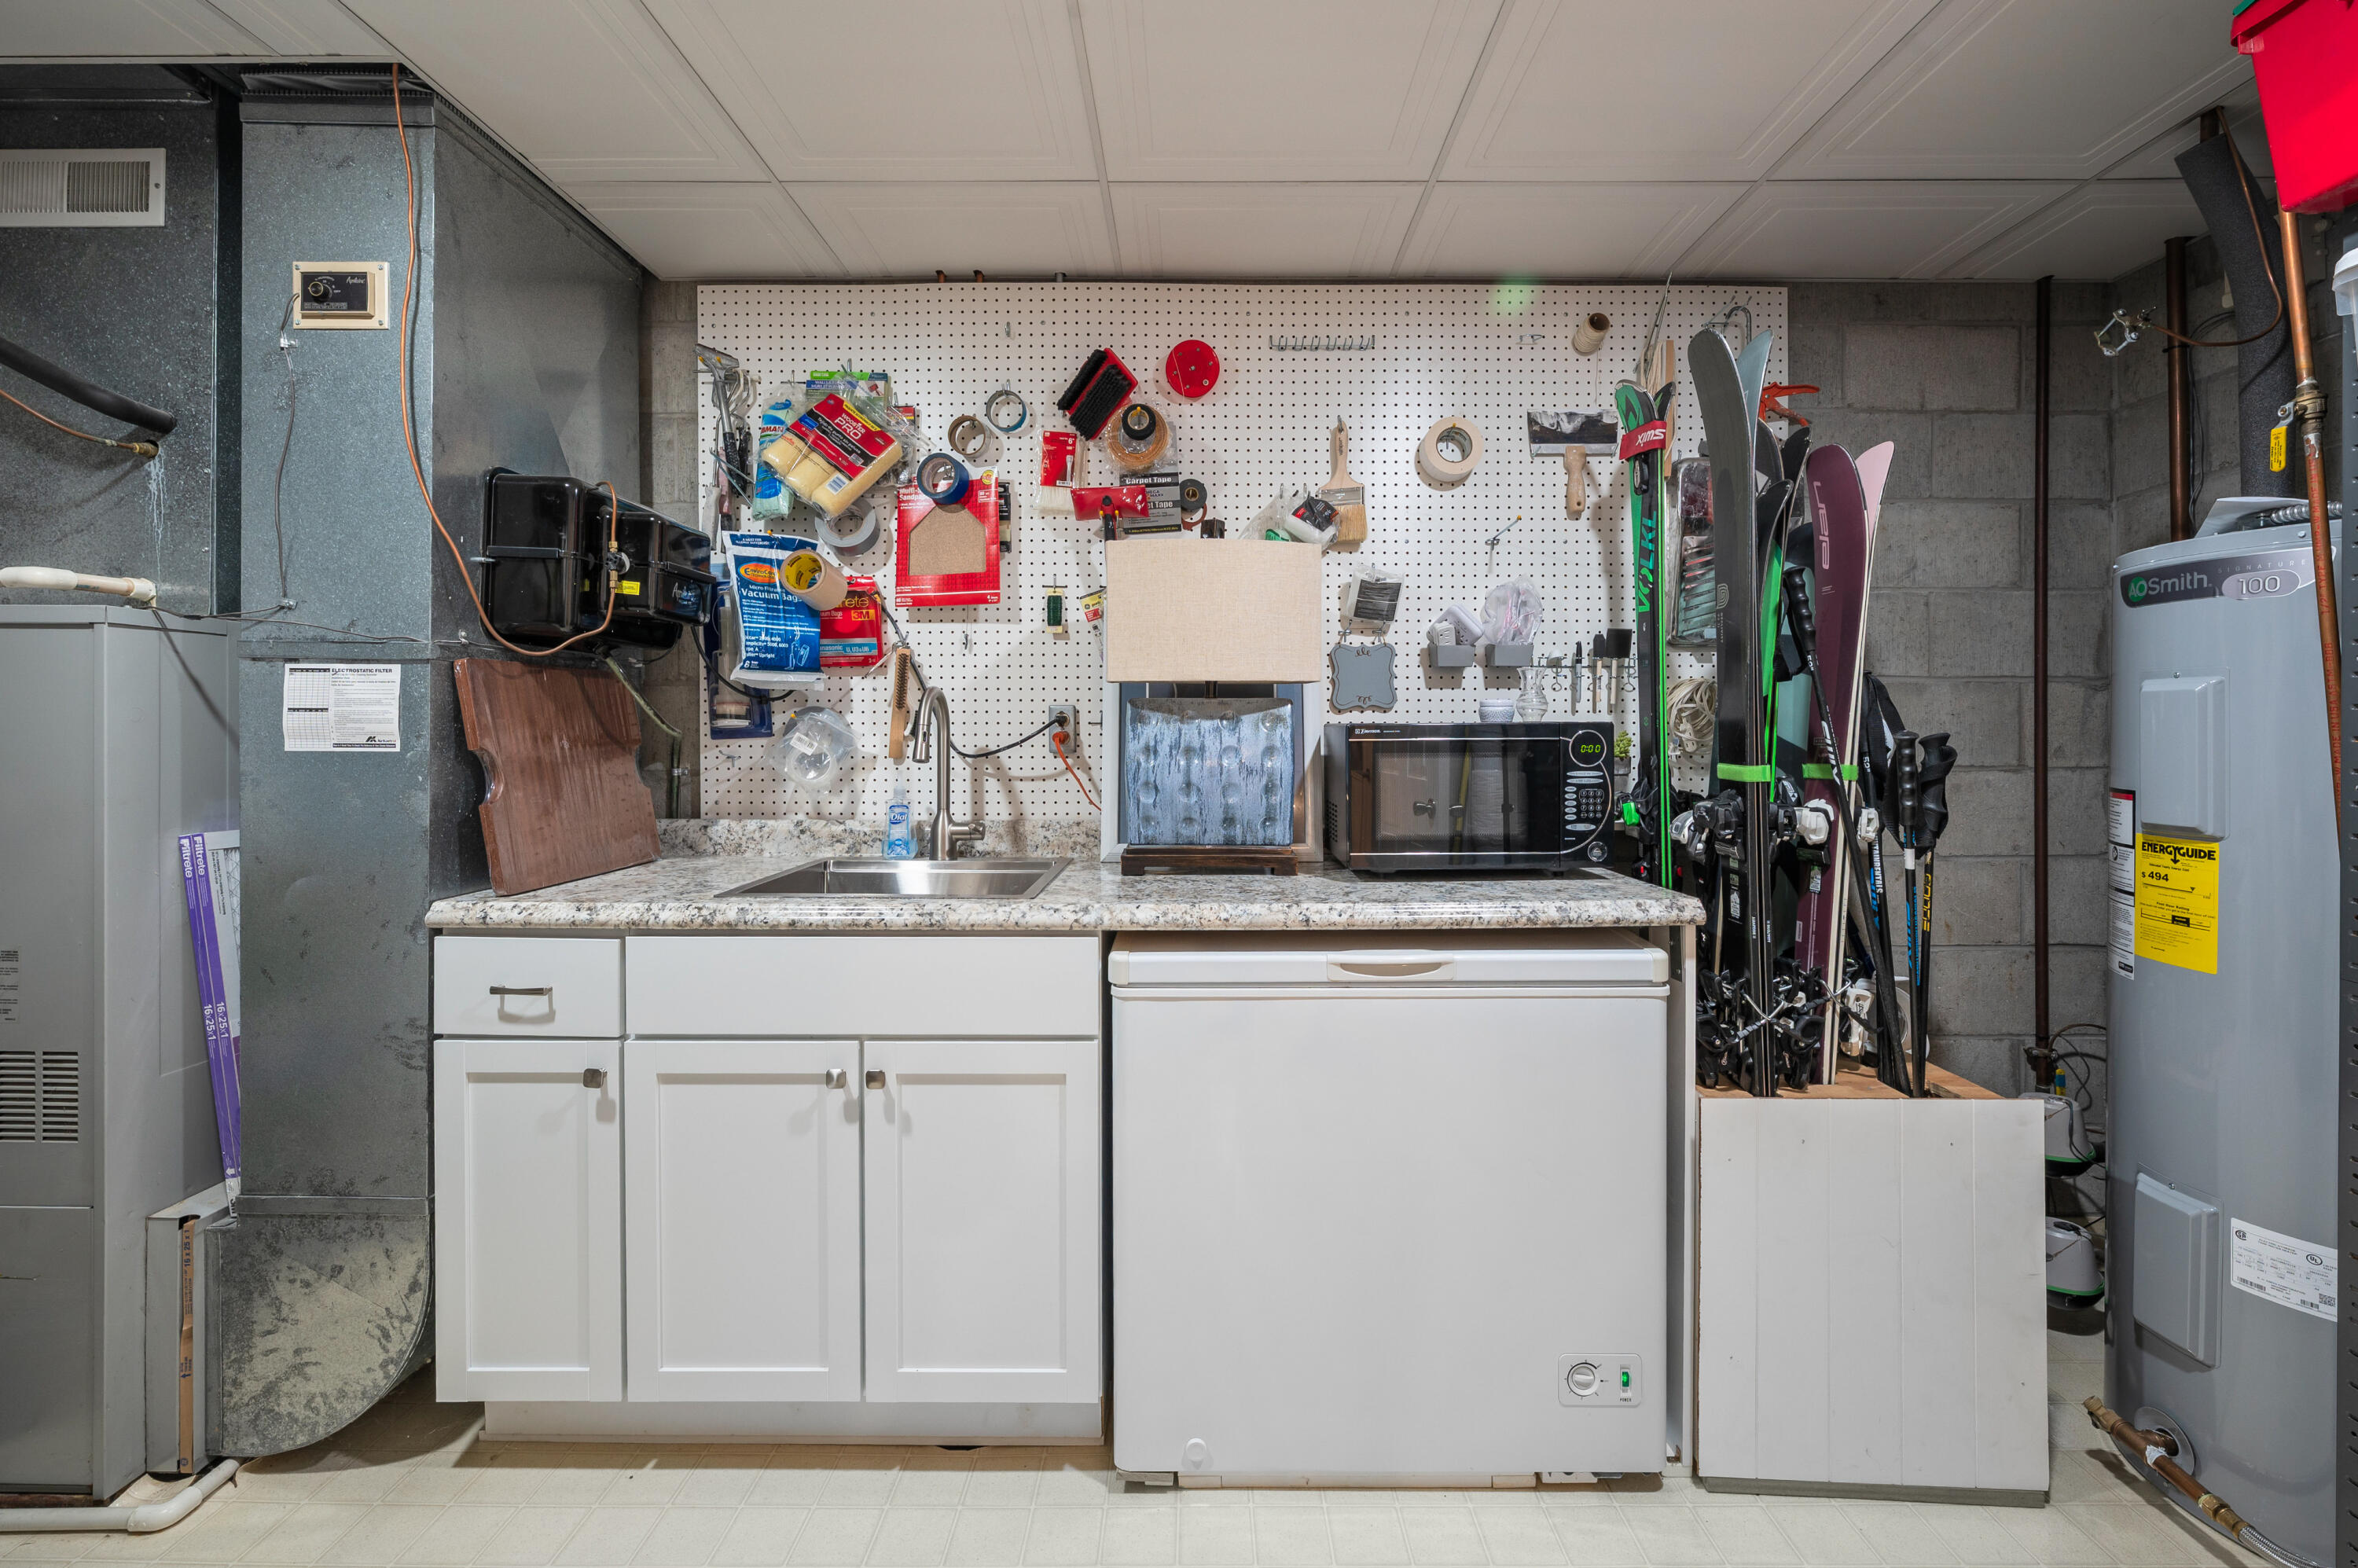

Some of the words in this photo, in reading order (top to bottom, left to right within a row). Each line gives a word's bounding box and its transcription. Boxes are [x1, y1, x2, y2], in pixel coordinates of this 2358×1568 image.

[834, 417, 861, 439] PRO
[842, 413, 865, 434] WOOSTER
[1636, 428, 1666, 446] SWIX
[1813, 481, 1830, 570] elan
[2218, 560, 2306, 574] SIGNATURE
[2148, 571, 2209, 595] Smith
[2239, 576, 2280, 594] 100
[741, 588, 780, 600] Vacuum
[782, 594, 803, 603] Bag
[852, 610, 870, 619] 3M
[2330, 698, 2341, 720] USA
[2332, 721, 2341, 733] IN
[1581, 744, 1601, 753] 0:00
[2333, 735, 2341, 764] MADE
[179, 838, 193, 878] Filtrete
[193, 835, 205, 876] Filtrete
[2142, 842, 2216, 861] ENERGYGUIDE
[2148, 871, 2169, 882] 494
[204, 1004, 216, 1040] 16x25x1
[216, 1001, 229, 1037] 16x25x1
